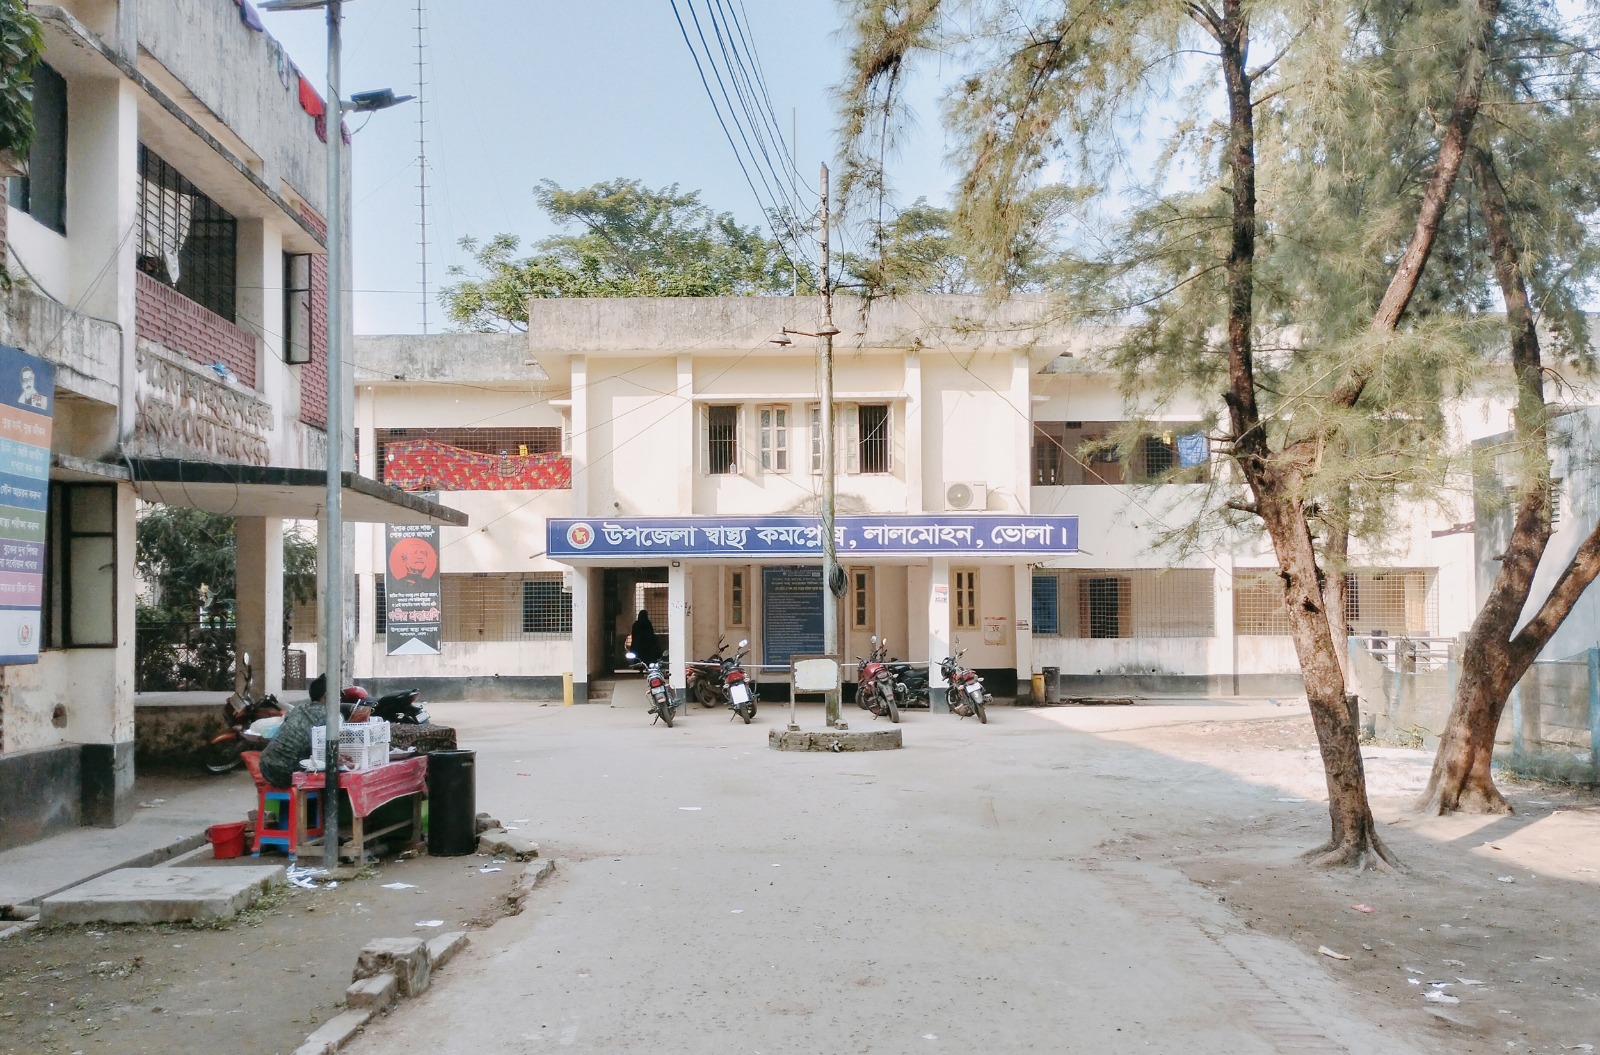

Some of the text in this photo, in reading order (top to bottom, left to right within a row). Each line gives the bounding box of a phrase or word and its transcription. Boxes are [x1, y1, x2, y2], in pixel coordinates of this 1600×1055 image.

[602, 522, 698, 547] উপজেলা
[702, 525, 750, 550] স্বাস্থ্য
[862, 524, 983, 549] লালমোহন,
[990, 524, 1054, 546] ভোলা
